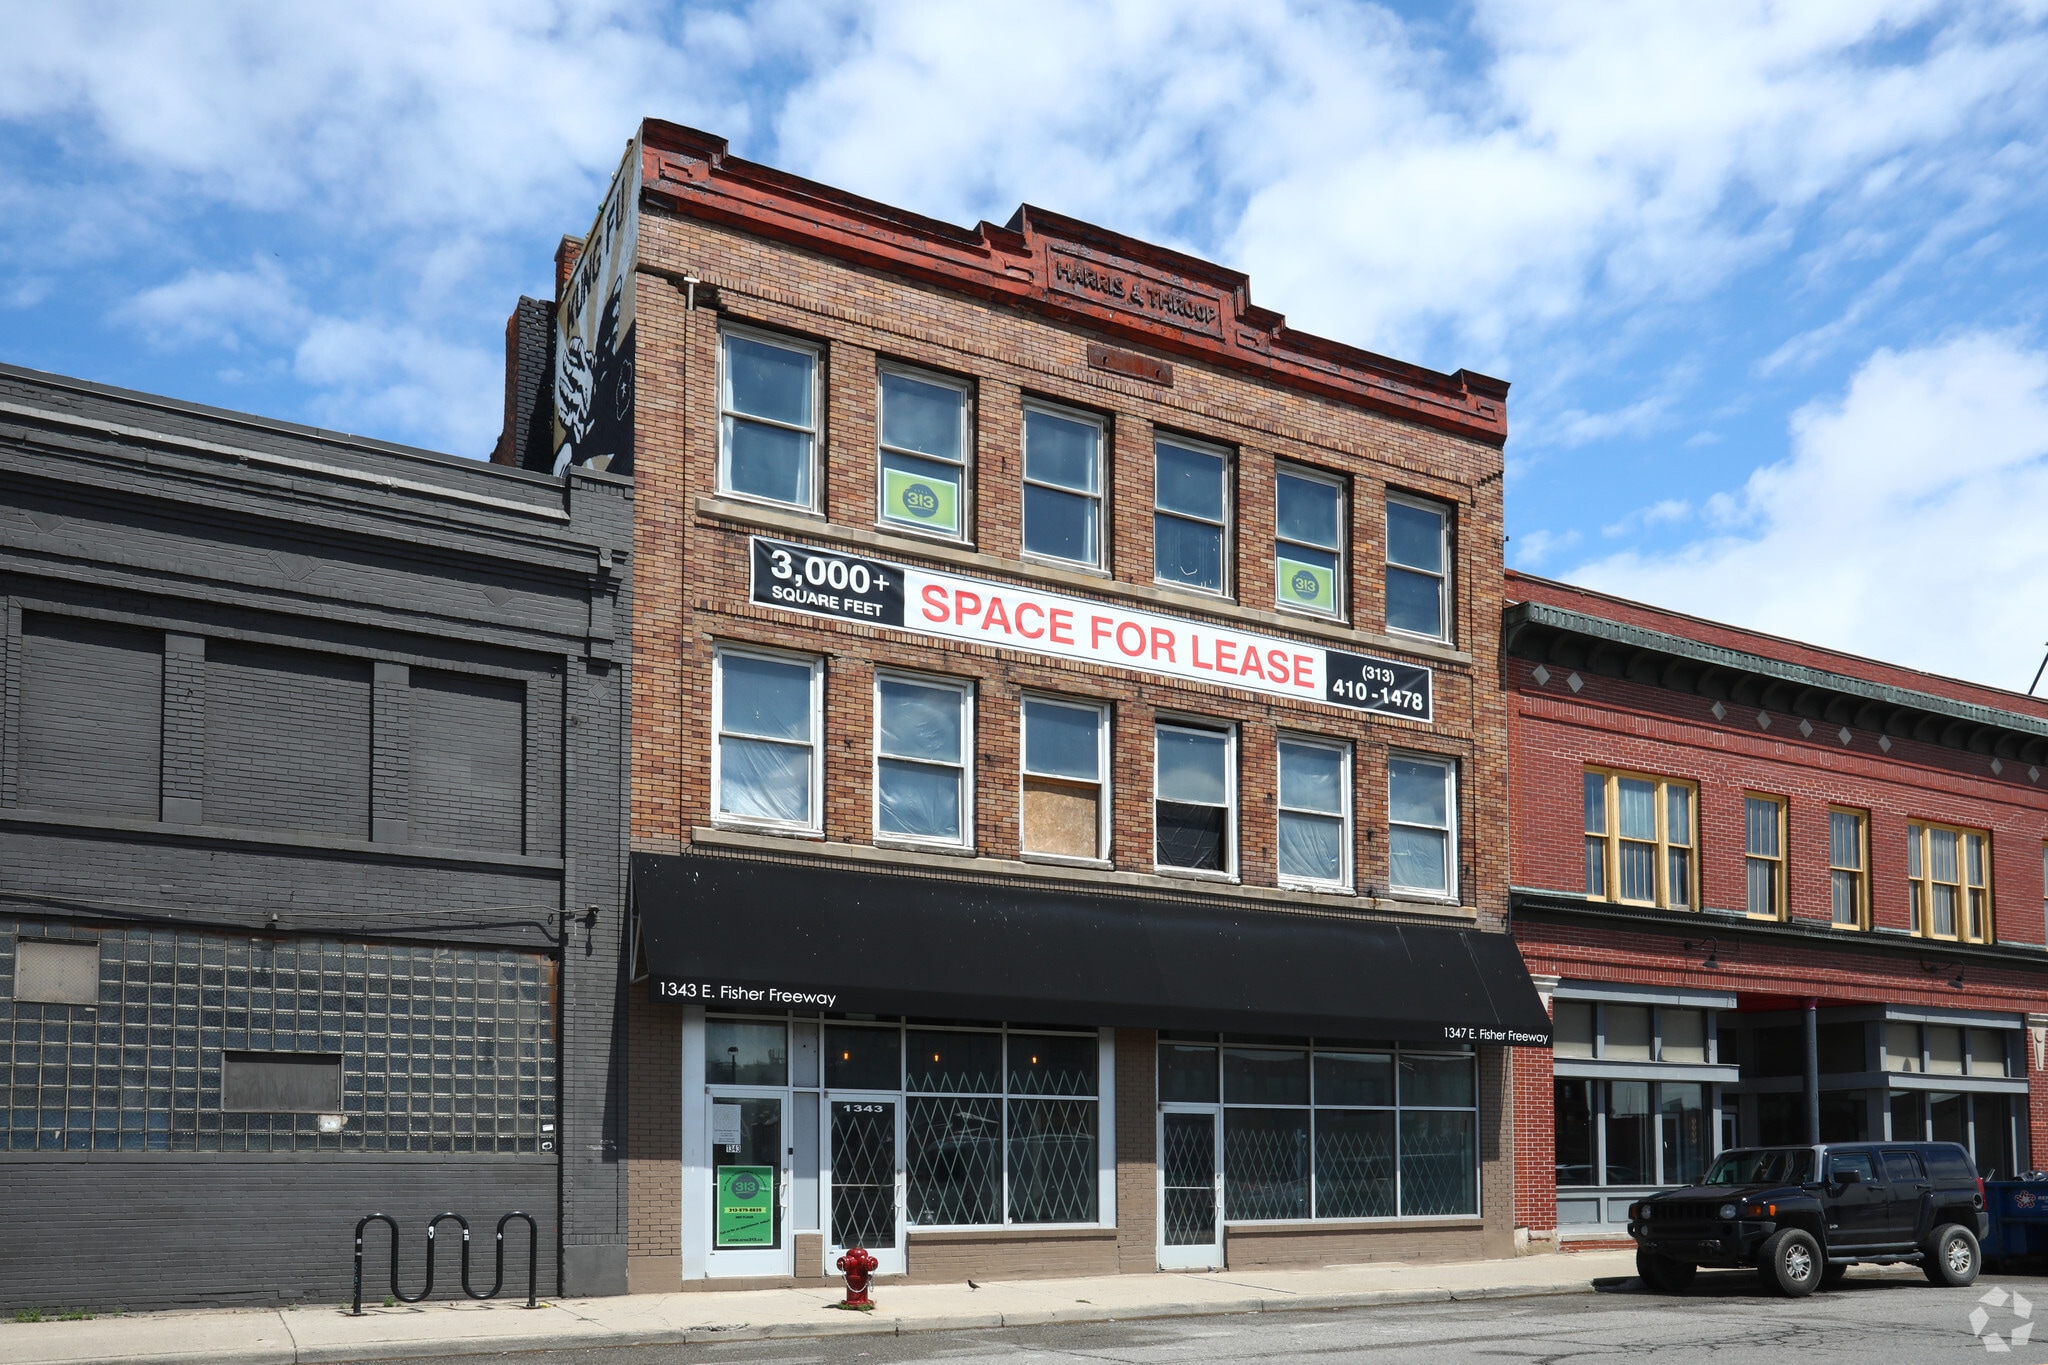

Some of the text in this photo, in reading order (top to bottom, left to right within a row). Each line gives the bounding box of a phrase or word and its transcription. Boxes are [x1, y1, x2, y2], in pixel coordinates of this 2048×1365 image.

[566, 177, 625, 339] KUNG FU
[1056, 261, 1216, 324] HARRIS & THROOP
[908, 491, 934, 509] 313
[771, 549, 890, 594] 3,000+
[1295, 577, 1316, 592] 313
[772, 585, 883, 617] SQUARE FEET
[922, 585, 1315, 689] SPACE FOR LEASE
[1362, 664, 1395, 686] (313)
[660, 982, 836, 1007] 1343 E. Fisher Freeway
[1444, 1027, 1549, 1045] 1347 E. Fisher Freeway
[843, 1104, 883, 1113] 1343
[735, 1181, 756, 1192] 313
